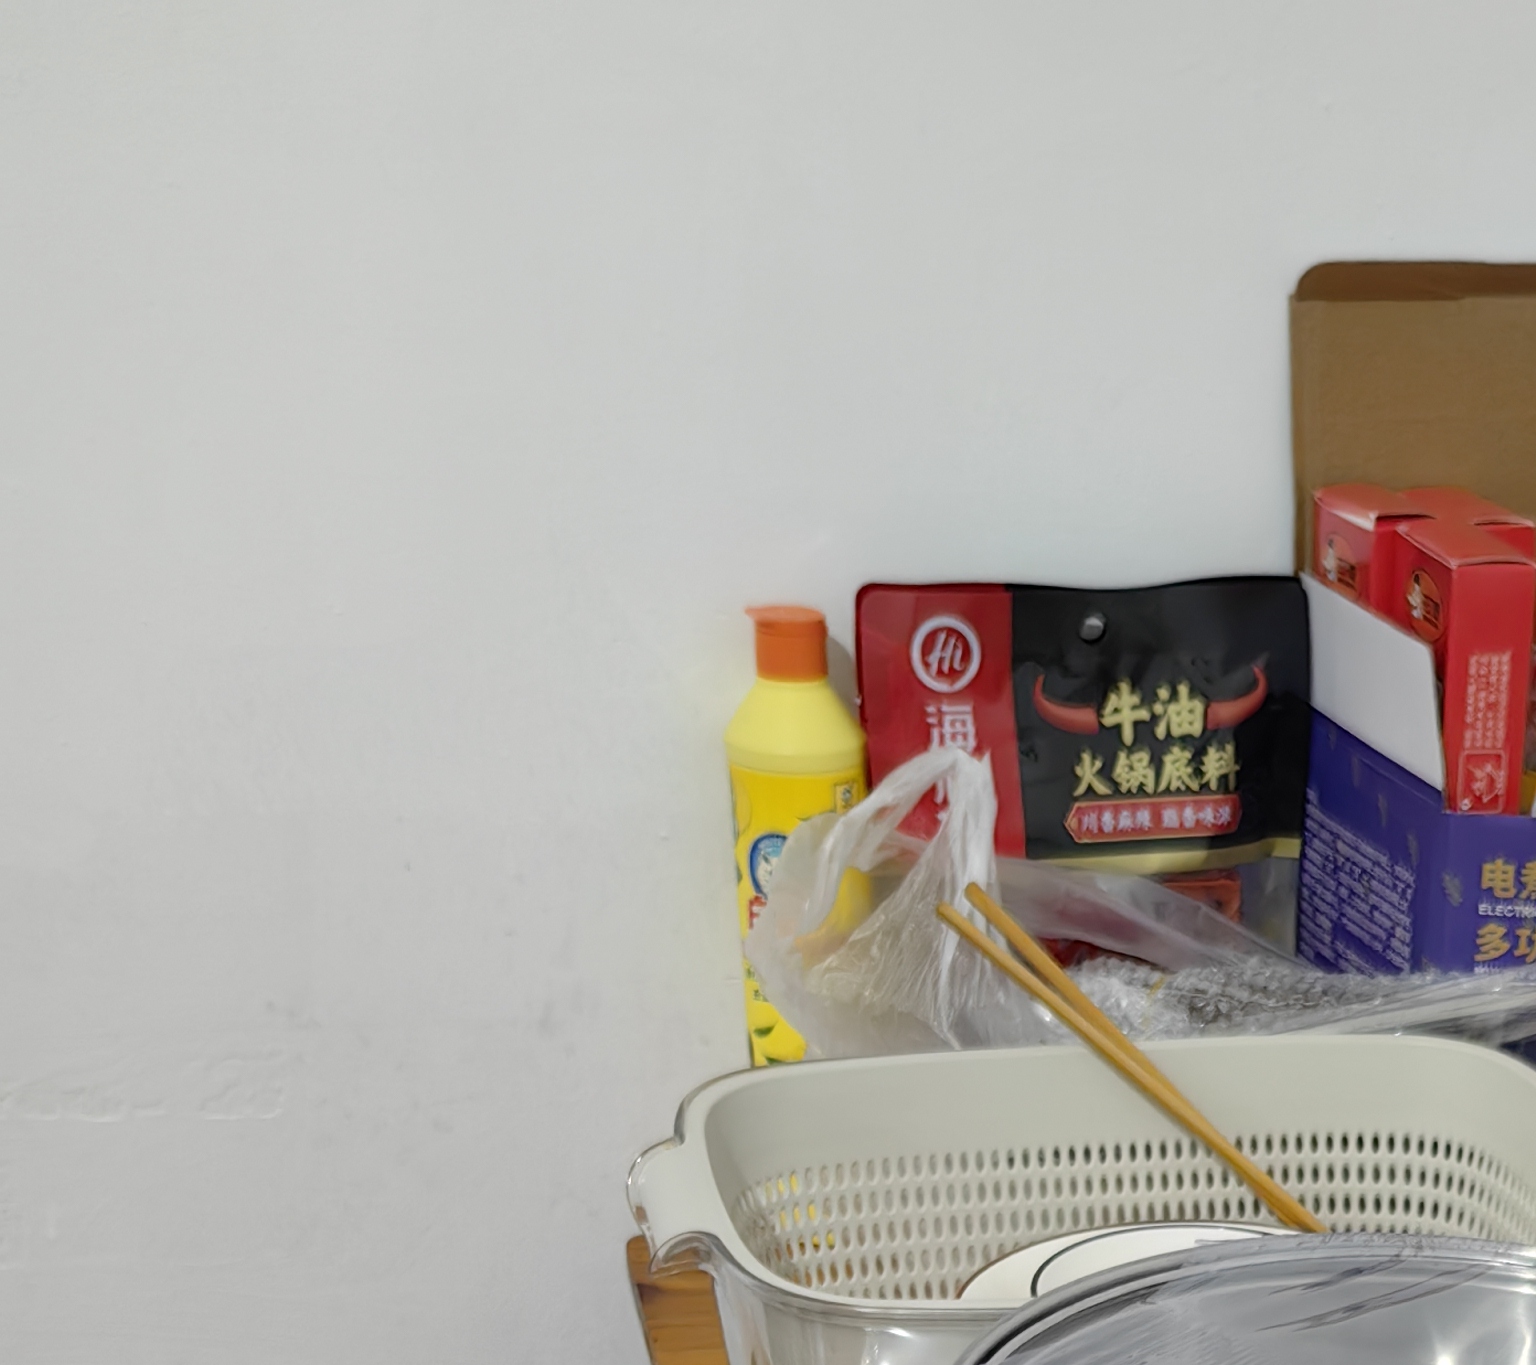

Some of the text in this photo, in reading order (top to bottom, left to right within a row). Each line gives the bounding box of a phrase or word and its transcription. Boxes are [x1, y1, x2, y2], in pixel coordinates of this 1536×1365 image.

[1100, 679, 1205, 746] 牛油
[1073, 743, 1241, 797] 火锅底料
